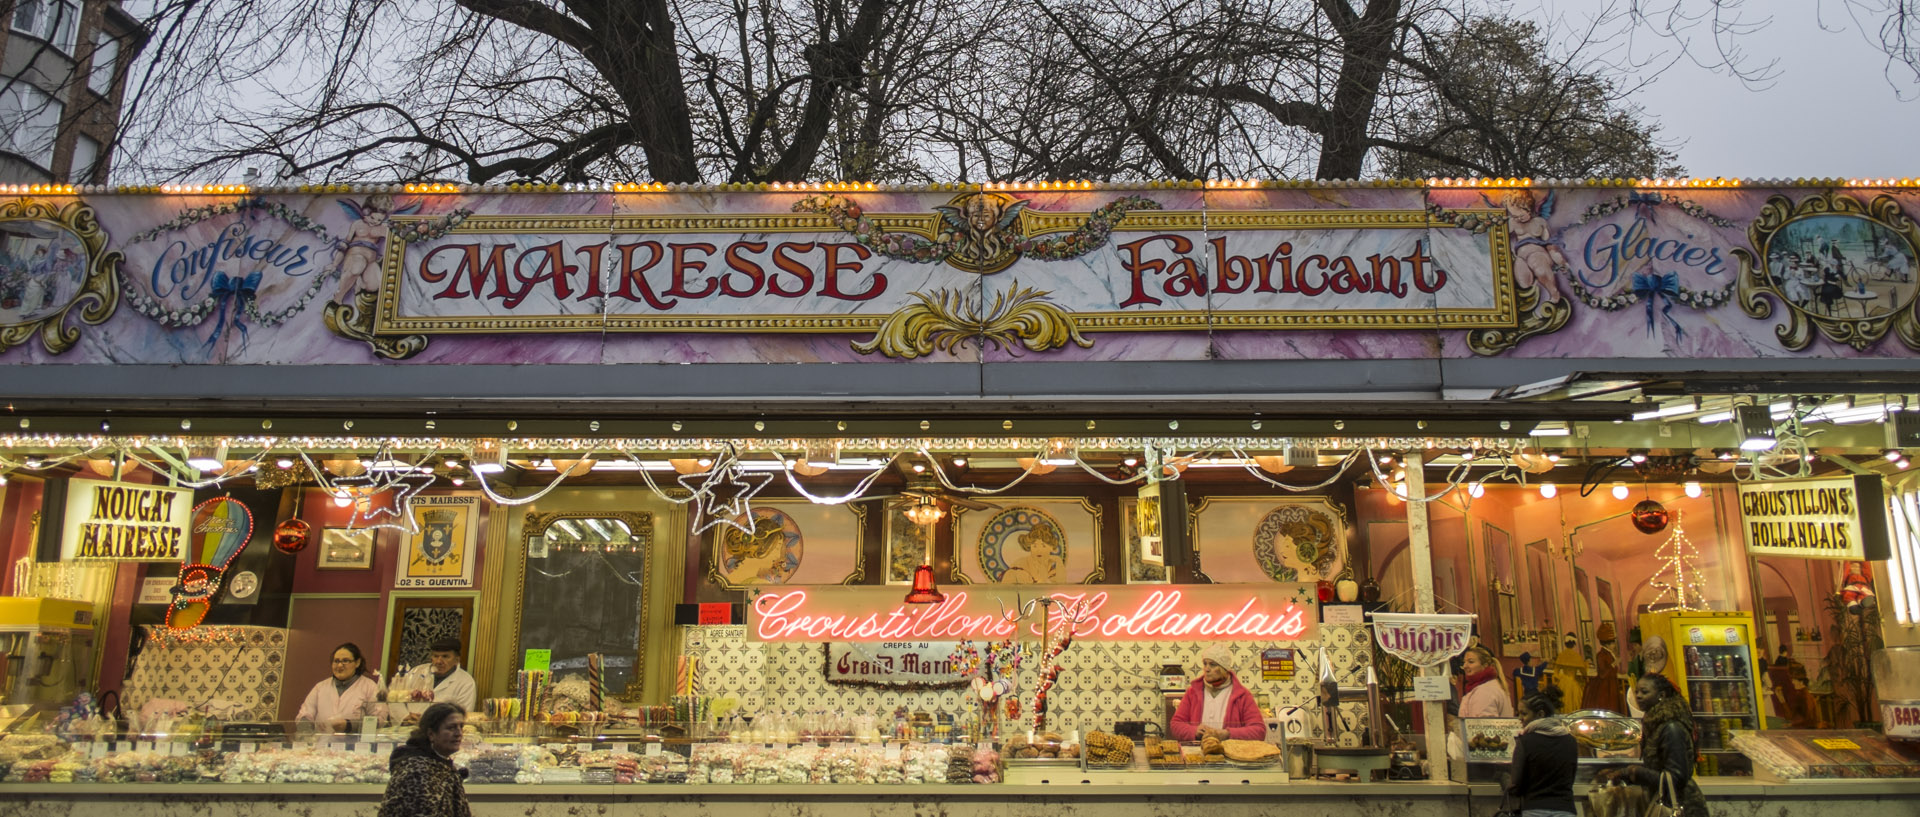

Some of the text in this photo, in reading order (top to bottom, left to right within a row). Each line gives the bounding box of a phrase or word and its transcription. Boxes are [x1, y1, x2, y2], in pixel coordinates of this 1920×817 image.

[152, 221, 314, 299] Confiseur
[1577, 216, 1729, 288] Glacier
[419, 233, 1446, 310] MAIRESSE Fabricant
[95, 485, 177, 522] NOUGAT
[410, 496, 475, 505] ETS MAIRESSE
[1742, 487, 1852, 517] CROUSTILLONS
[77, 523, 182, 557] MAIRESSE
[1750, 521, 1849, 550] HOLLANDAIS
[399, 578, 468, 587] 02 St QUENTIN
[755, 590, 1307, 640] Croustillons Hollandais
[1381, 627, 1463, 653] Chichis
[836, 651, 952, 675] Grand Marn
